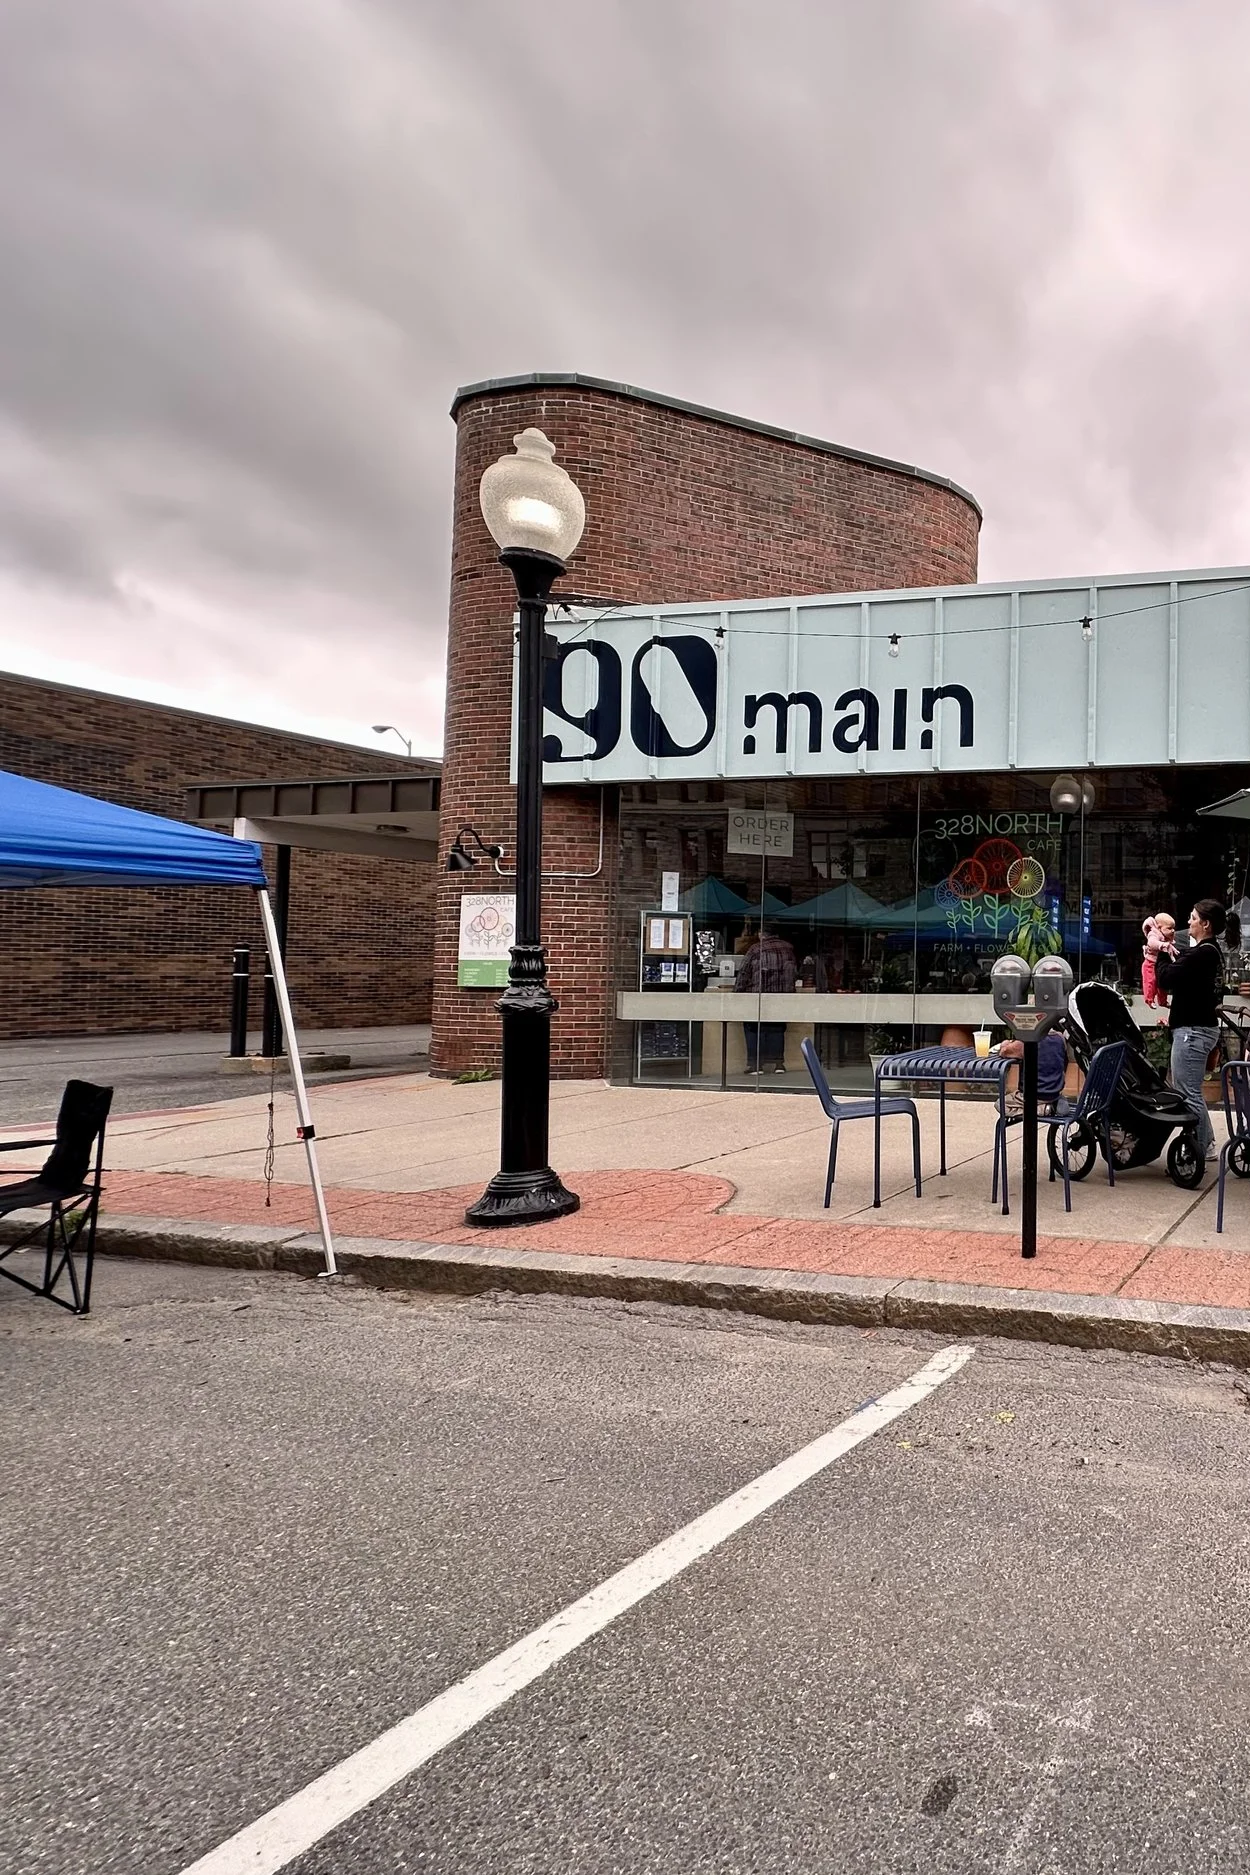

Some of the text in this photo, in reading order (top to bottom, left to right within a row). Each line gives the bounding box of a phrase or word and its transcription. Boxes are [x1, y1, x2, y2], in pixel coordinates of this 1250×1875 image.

[542, 634, 974, 763] 90 main
[733, 816, 789, 831] ORDER
[935, 813, 1063, 839] 328NORTH
[740, 833, 782, 847] HERE
[1027, 840, 1062, 850] CAFE
[466, 895, 514, 908] 328NORTH
[933, 944, 963, 953] FARM
[974, 944, 1021, 954] FLOWE
